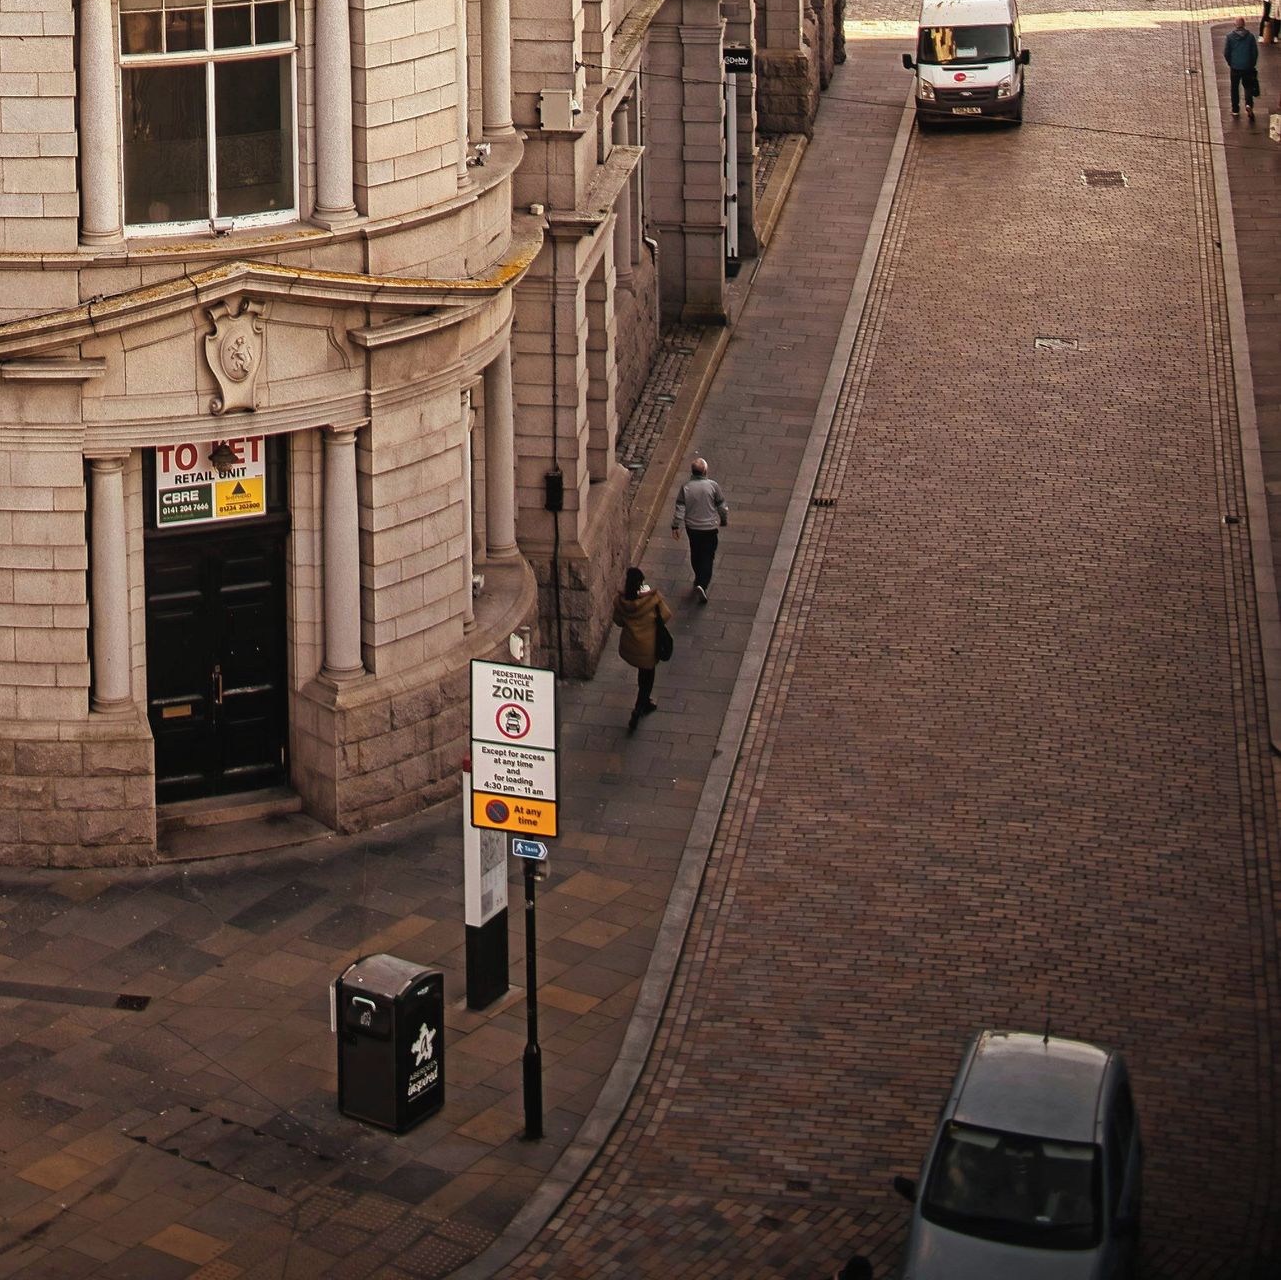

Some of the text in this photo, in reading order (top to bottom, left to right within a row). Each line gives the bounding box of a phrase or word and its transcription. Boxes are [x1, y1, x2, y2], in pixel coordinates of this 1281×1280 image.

[157, 435, 264, 473] TO ET
[174, 467, 247, 485] RETAIL UNIT
[162, 489, 200, 505] CBRE
[162, 505, 179, 515] 0141
[180, 503, 193, 513] 204
[492, 669, 534, 681] PEDESTRIAN
[509, 679, 530, 687] CYCLE
[492, 685, 535, 703] ZONE
[481, 746, 546, 762] Except for access
[502, 759, 516, 767] any
[517, 760, 534, 769] time
[494, 773, 534, 787] for loading
[484, 781, 502, 789] 4:30
[524, 786, 531, 794] 11
[514, 805, 542, 818] At any
[518, 816, 538, 826] time
[407, 1064, 438, 1096] inspired
